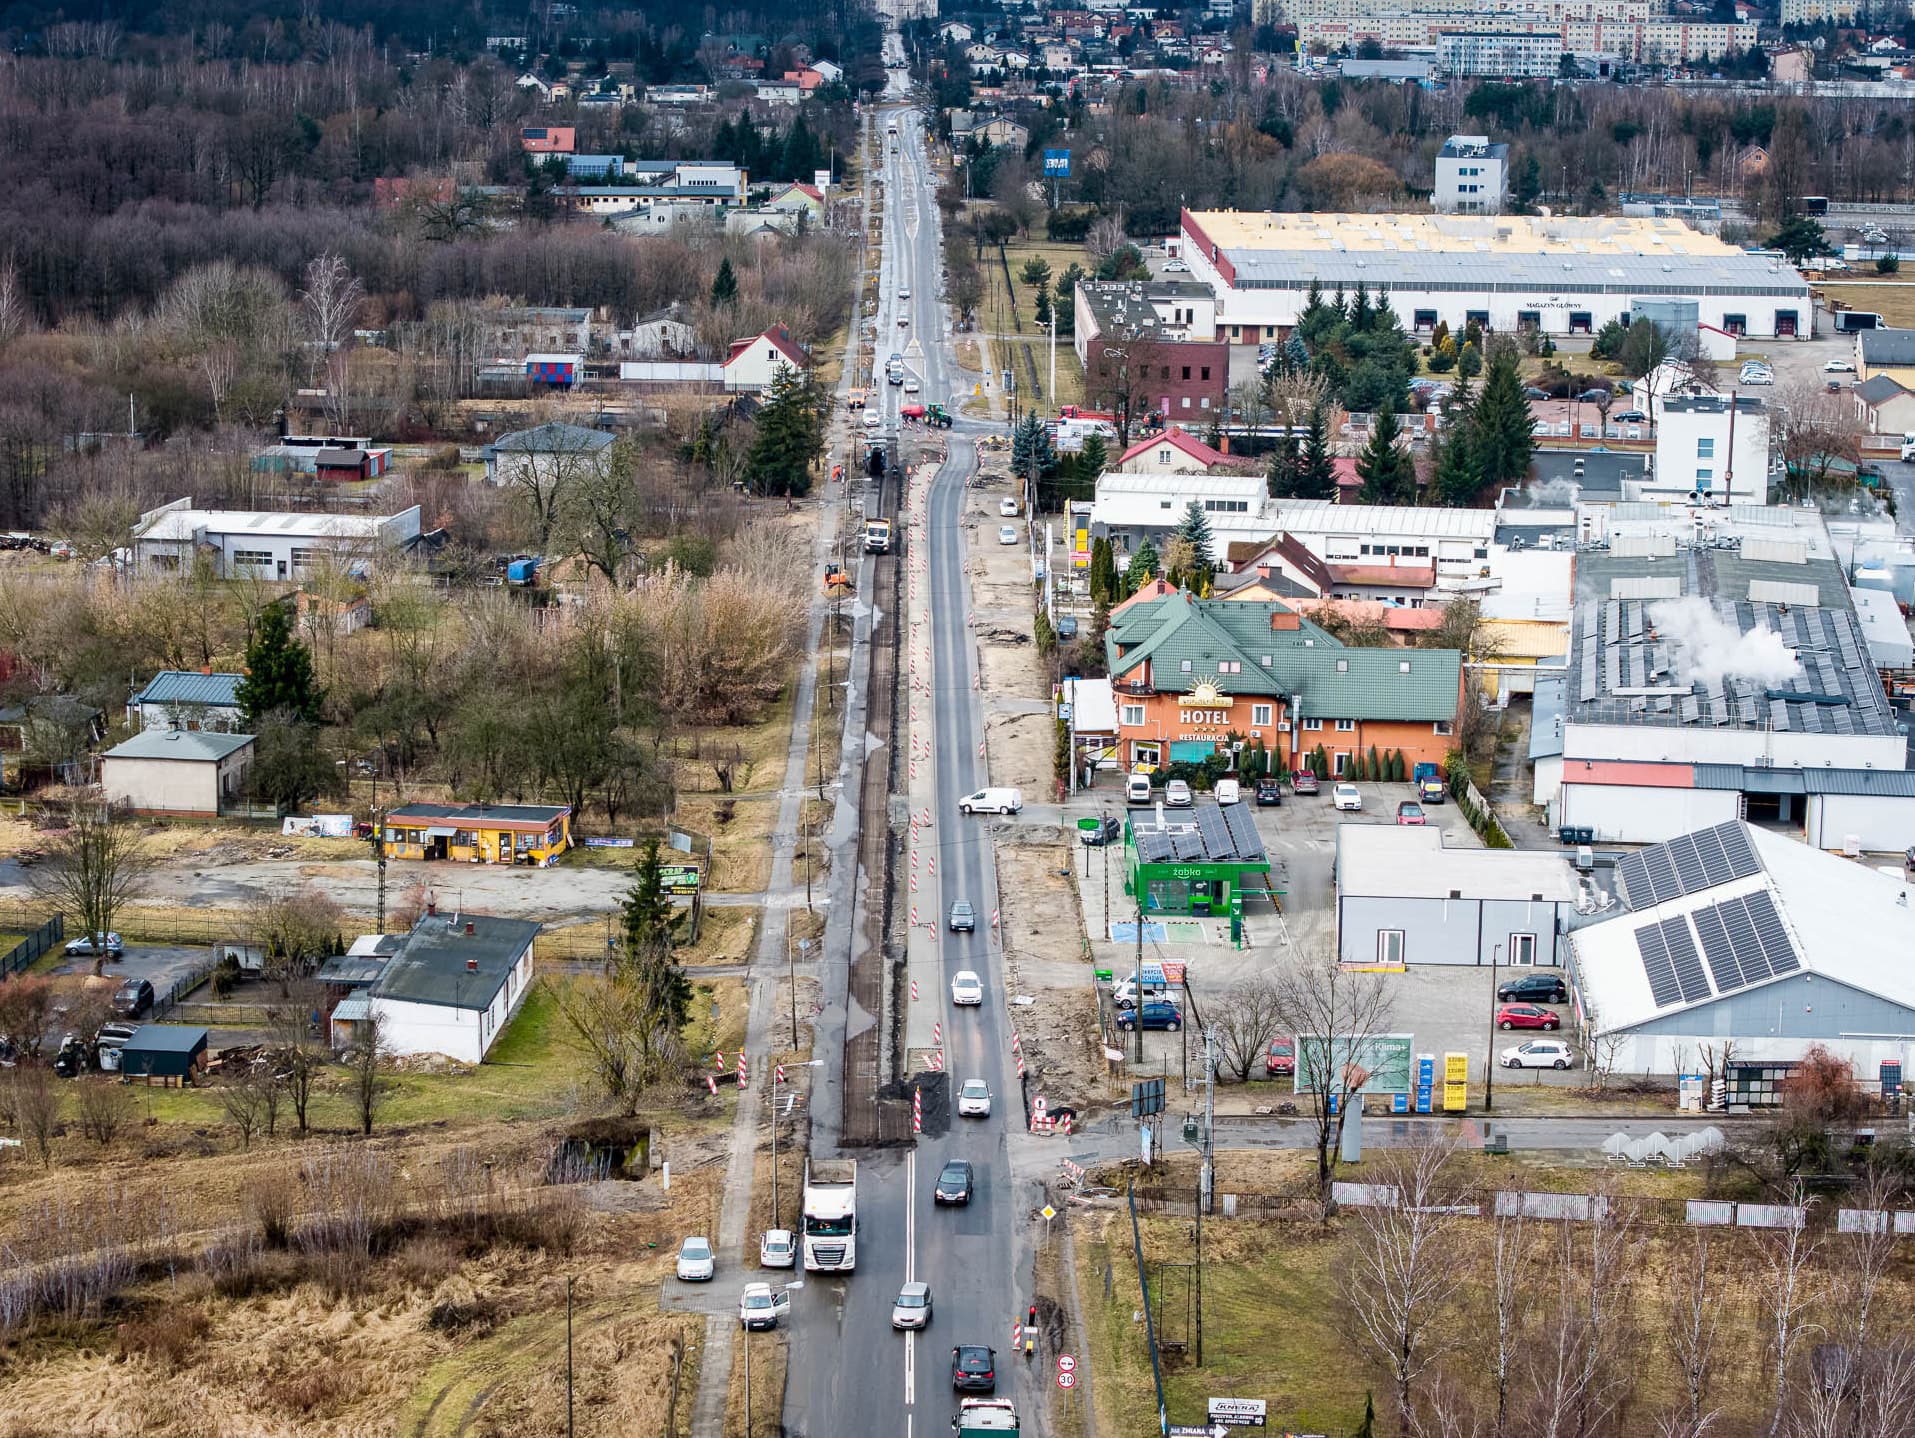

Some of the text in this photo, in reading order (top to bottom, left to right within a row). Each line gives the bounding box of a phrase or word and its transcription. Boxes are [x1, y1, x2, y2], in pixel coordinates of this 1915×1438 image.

[1180, 710, 1230, 724] HOTEL
[1179, 734, 1230, 742] RESTAURACJA
[1173, 867, 1201, 876] żabka
[1375, 1042, 1408, 1051] Klima+
[1061, 1376, 1073, 1384] 30
